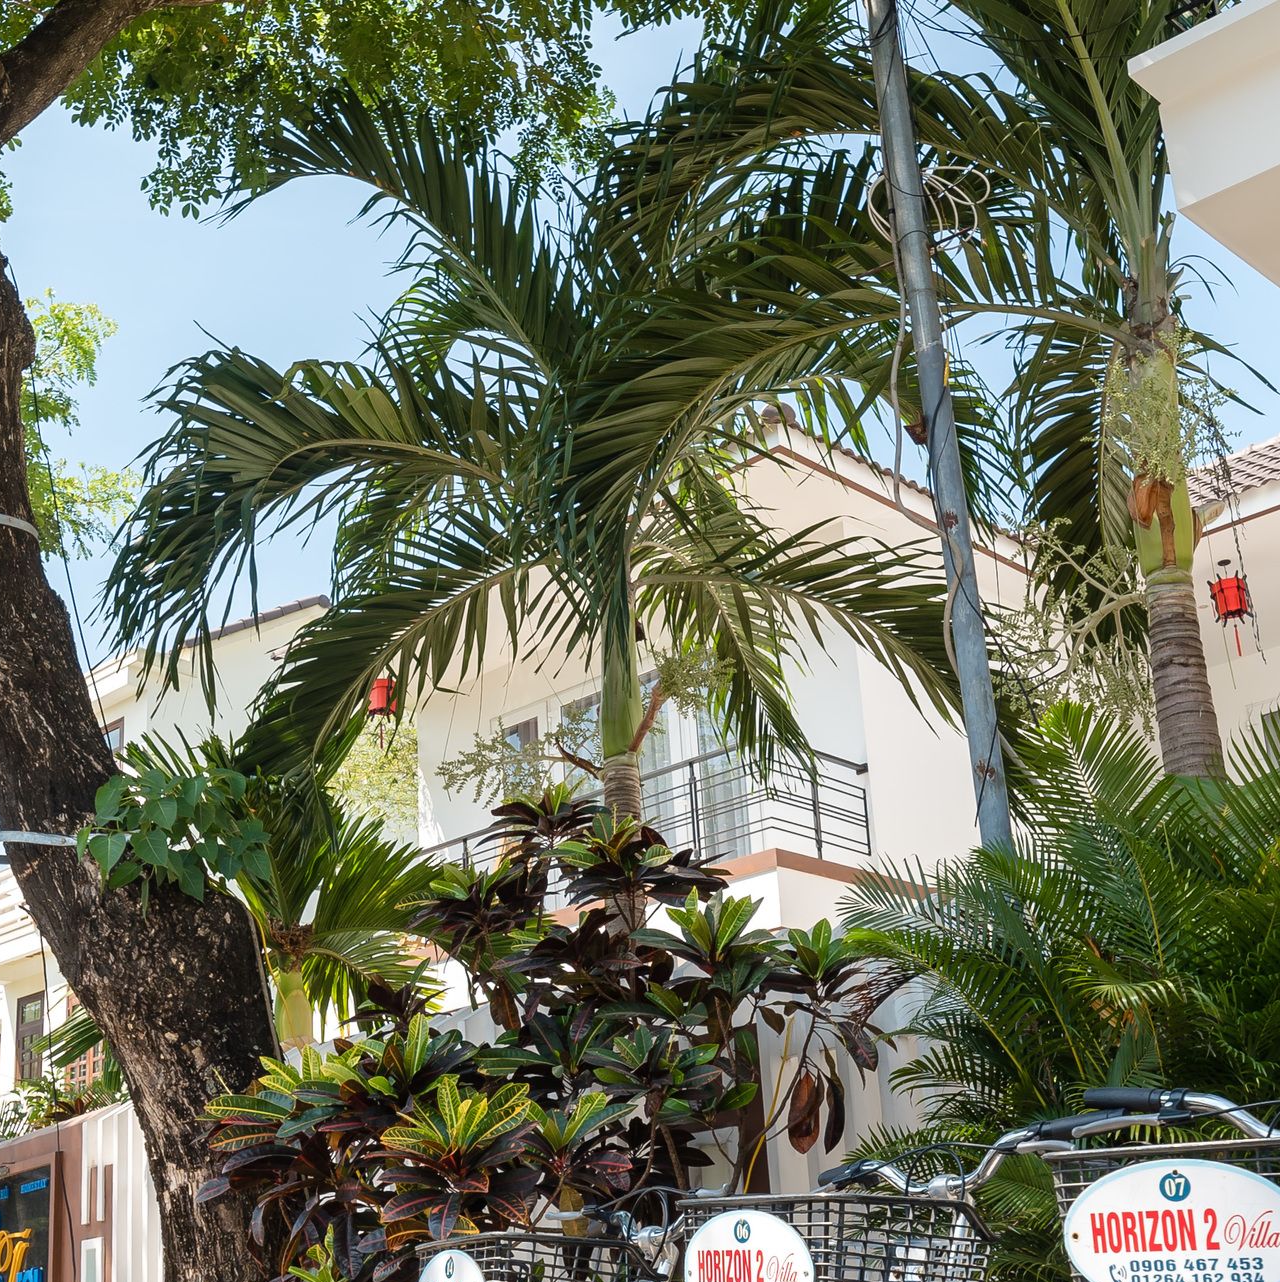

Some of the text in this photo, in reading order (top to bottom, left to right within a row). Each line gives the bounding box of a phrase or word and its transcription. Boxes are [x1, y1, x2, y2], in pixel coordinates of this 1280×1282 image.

[1164, 1177, 1186, 1197] 07
[736, 1223, 749, 1239] 06
[1090, 1209, 1197, 1254] HORIZON
[1203, 1208, 1221, 1251] 2
[1130, 1257, 1264, 1273] 0906 467 453
